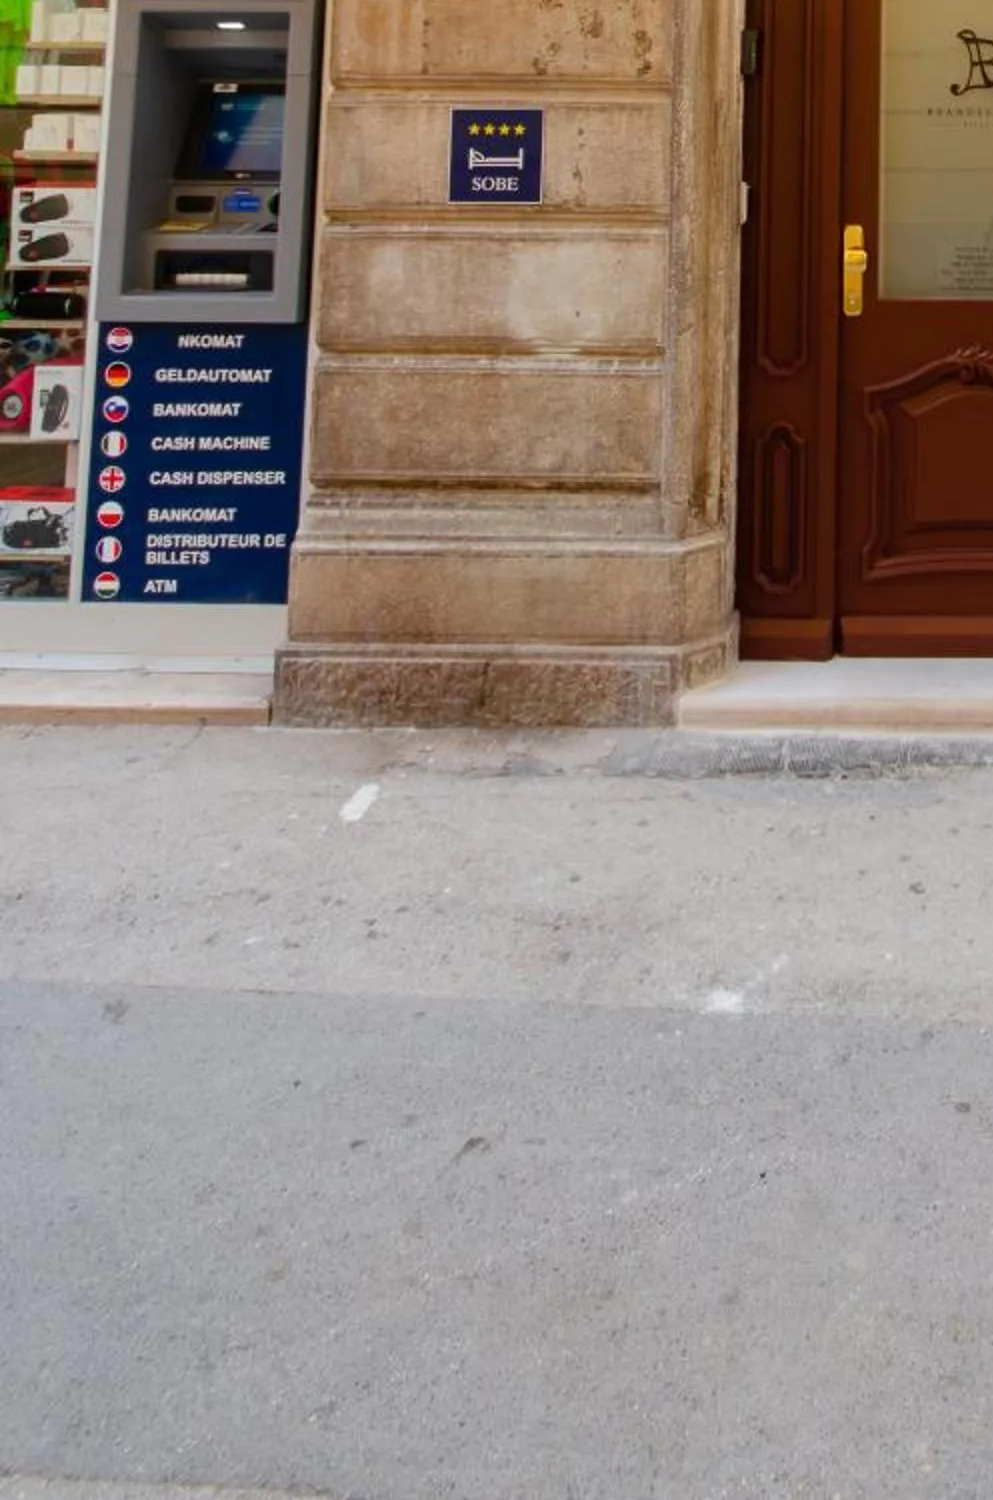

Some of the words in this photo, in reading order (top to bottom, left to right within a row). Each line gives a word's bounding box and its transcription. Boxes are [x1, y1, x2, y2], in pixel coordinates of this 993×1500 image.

[471, 177, 519, 192] SOBE
[178, 335, 245, 348] NKOMAT
[155, 368, 273, 383] GELDAUTOMAT
[153, 403, 242, 417] BANKOMAT
[151, 436, 195, 451] CASH
[199, 436, 271, 450] MACHINE
[150, 471, 193, 485] CASH
[197, 471, 286, 485] DISPENSER
[147, 508, 237, 523] BANKOMAT
[146, 534, 260, 548] DISTRIBUTEUR
[264, 534, 286, 547] DE
[145, 551, 210, 565] BILLETS
[144, 580, 177, 593] ATM
